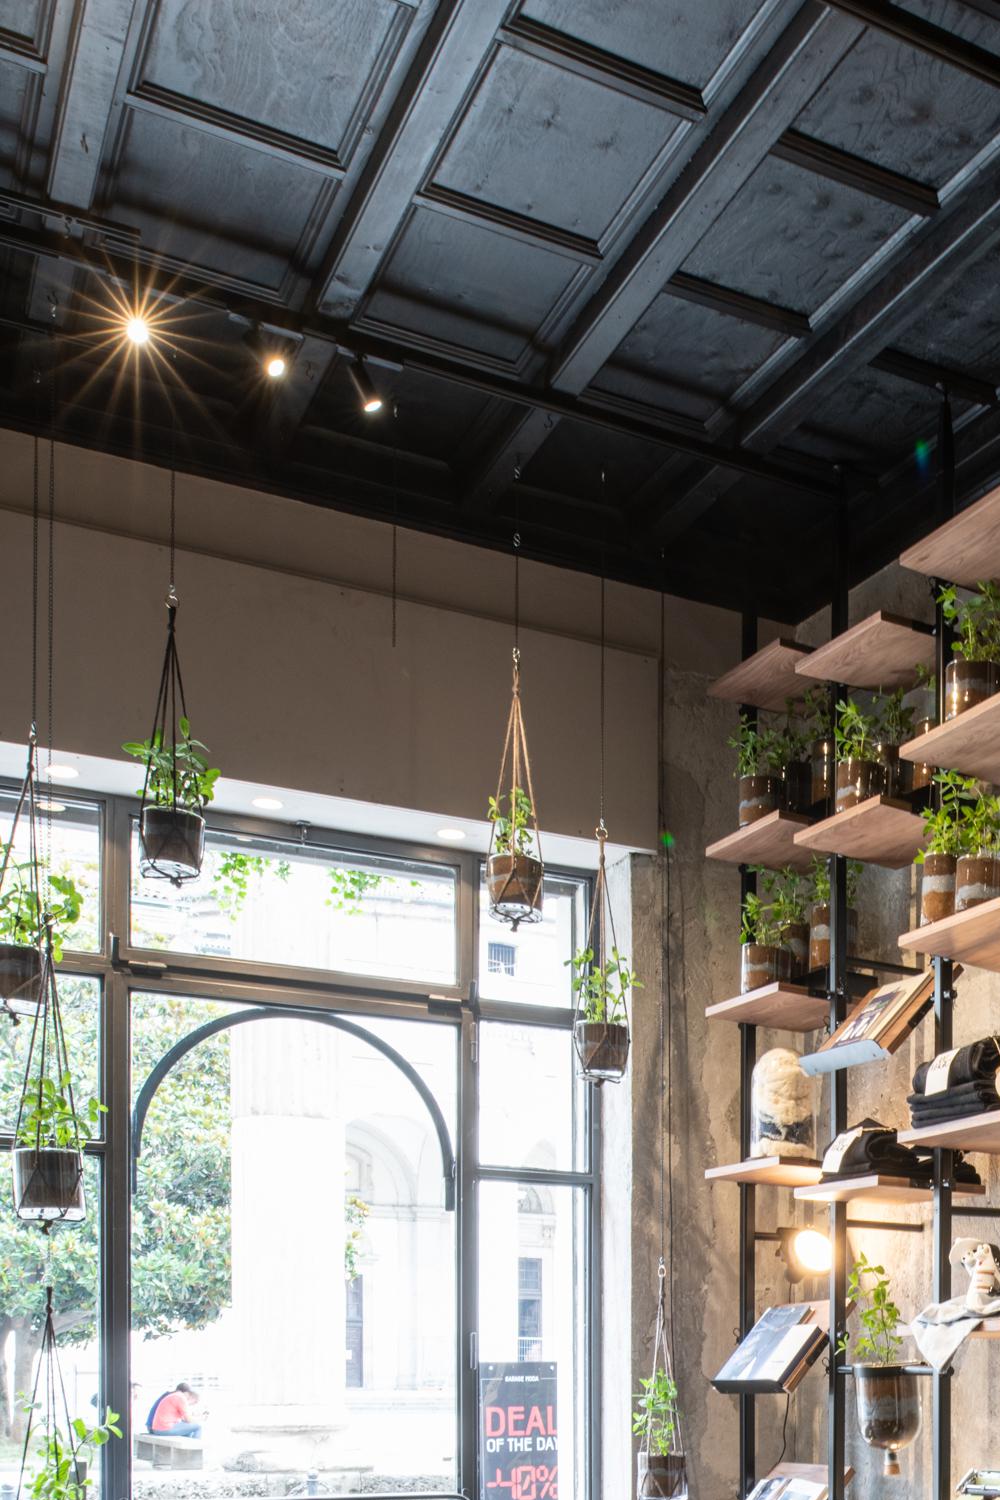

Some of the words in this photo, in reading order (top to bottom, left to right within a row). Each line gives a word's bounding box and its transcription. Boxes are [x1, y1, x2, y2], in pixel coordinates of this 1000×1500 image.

[485, 1405, 557, 1437] DEAL
[486, 1438, 504, 1453] OF
[507, 1437, 532, 1452] THE
[486, 1465, 558, 1500] -40%
